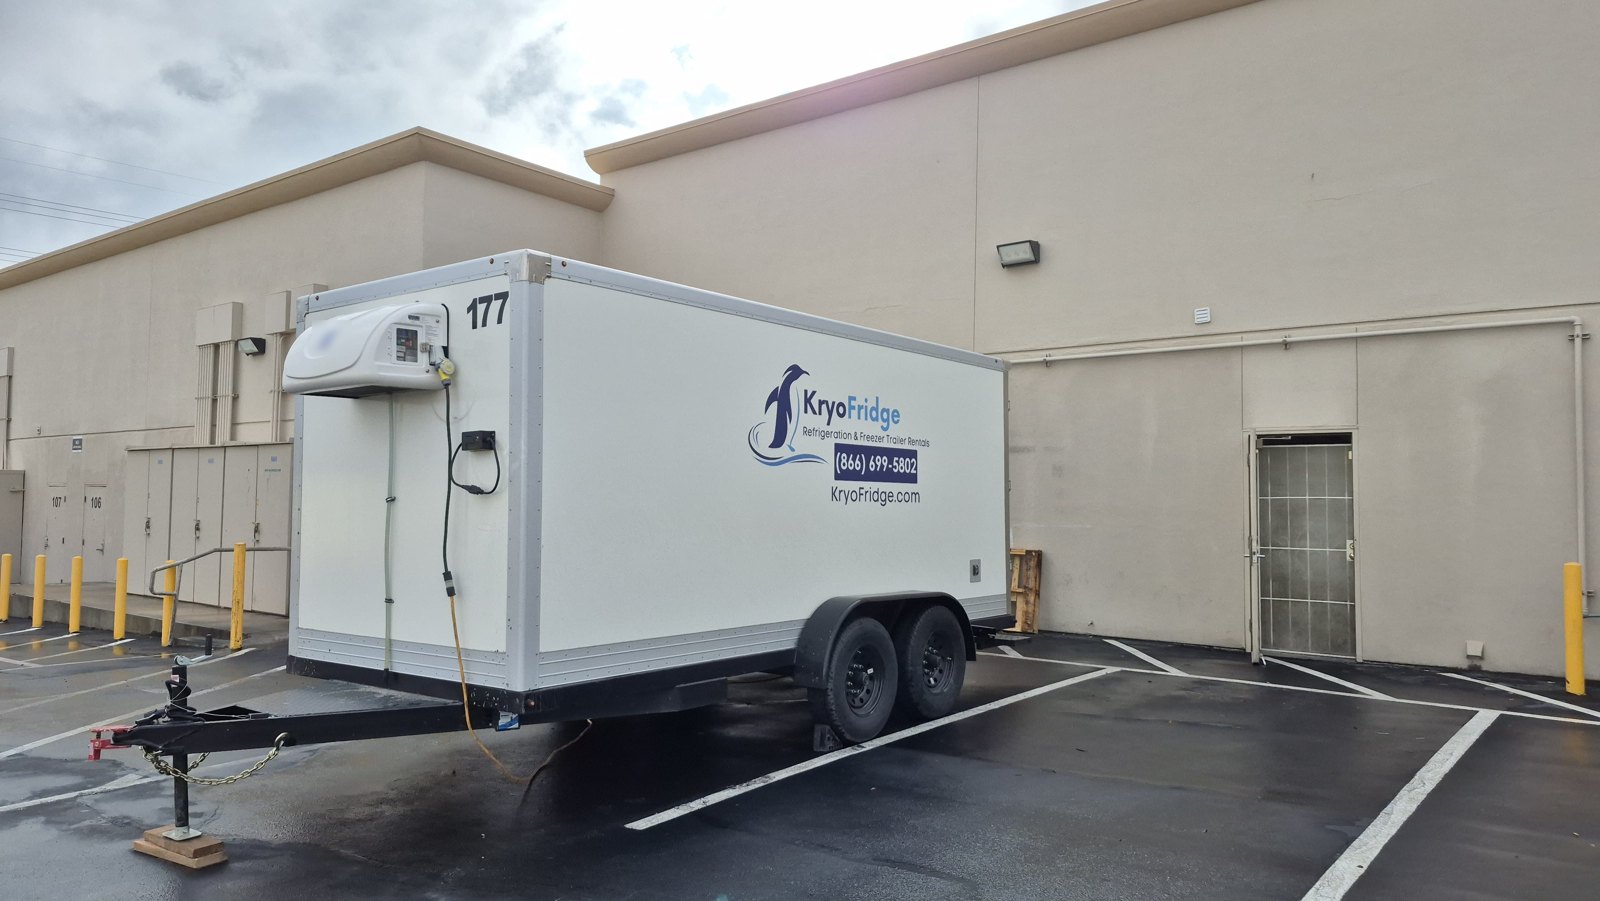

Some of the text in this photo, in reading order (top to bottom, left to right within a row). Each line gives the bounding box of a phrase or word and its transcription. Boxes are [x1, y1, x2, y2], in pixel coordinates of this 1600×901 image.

[466, 291, 509, 330] 177
[803, 389, 901, 431] KryoFridge
[802, 426, 930, 447] Refrigeration & Freezer Trailer Rentals
[836, 452, 917, 474] (866) 699-5802
[52, 496, 62, 508] 107
[90, 497, 102, 508] 106
[831, 486, 920, 506] KryoFridge.com
